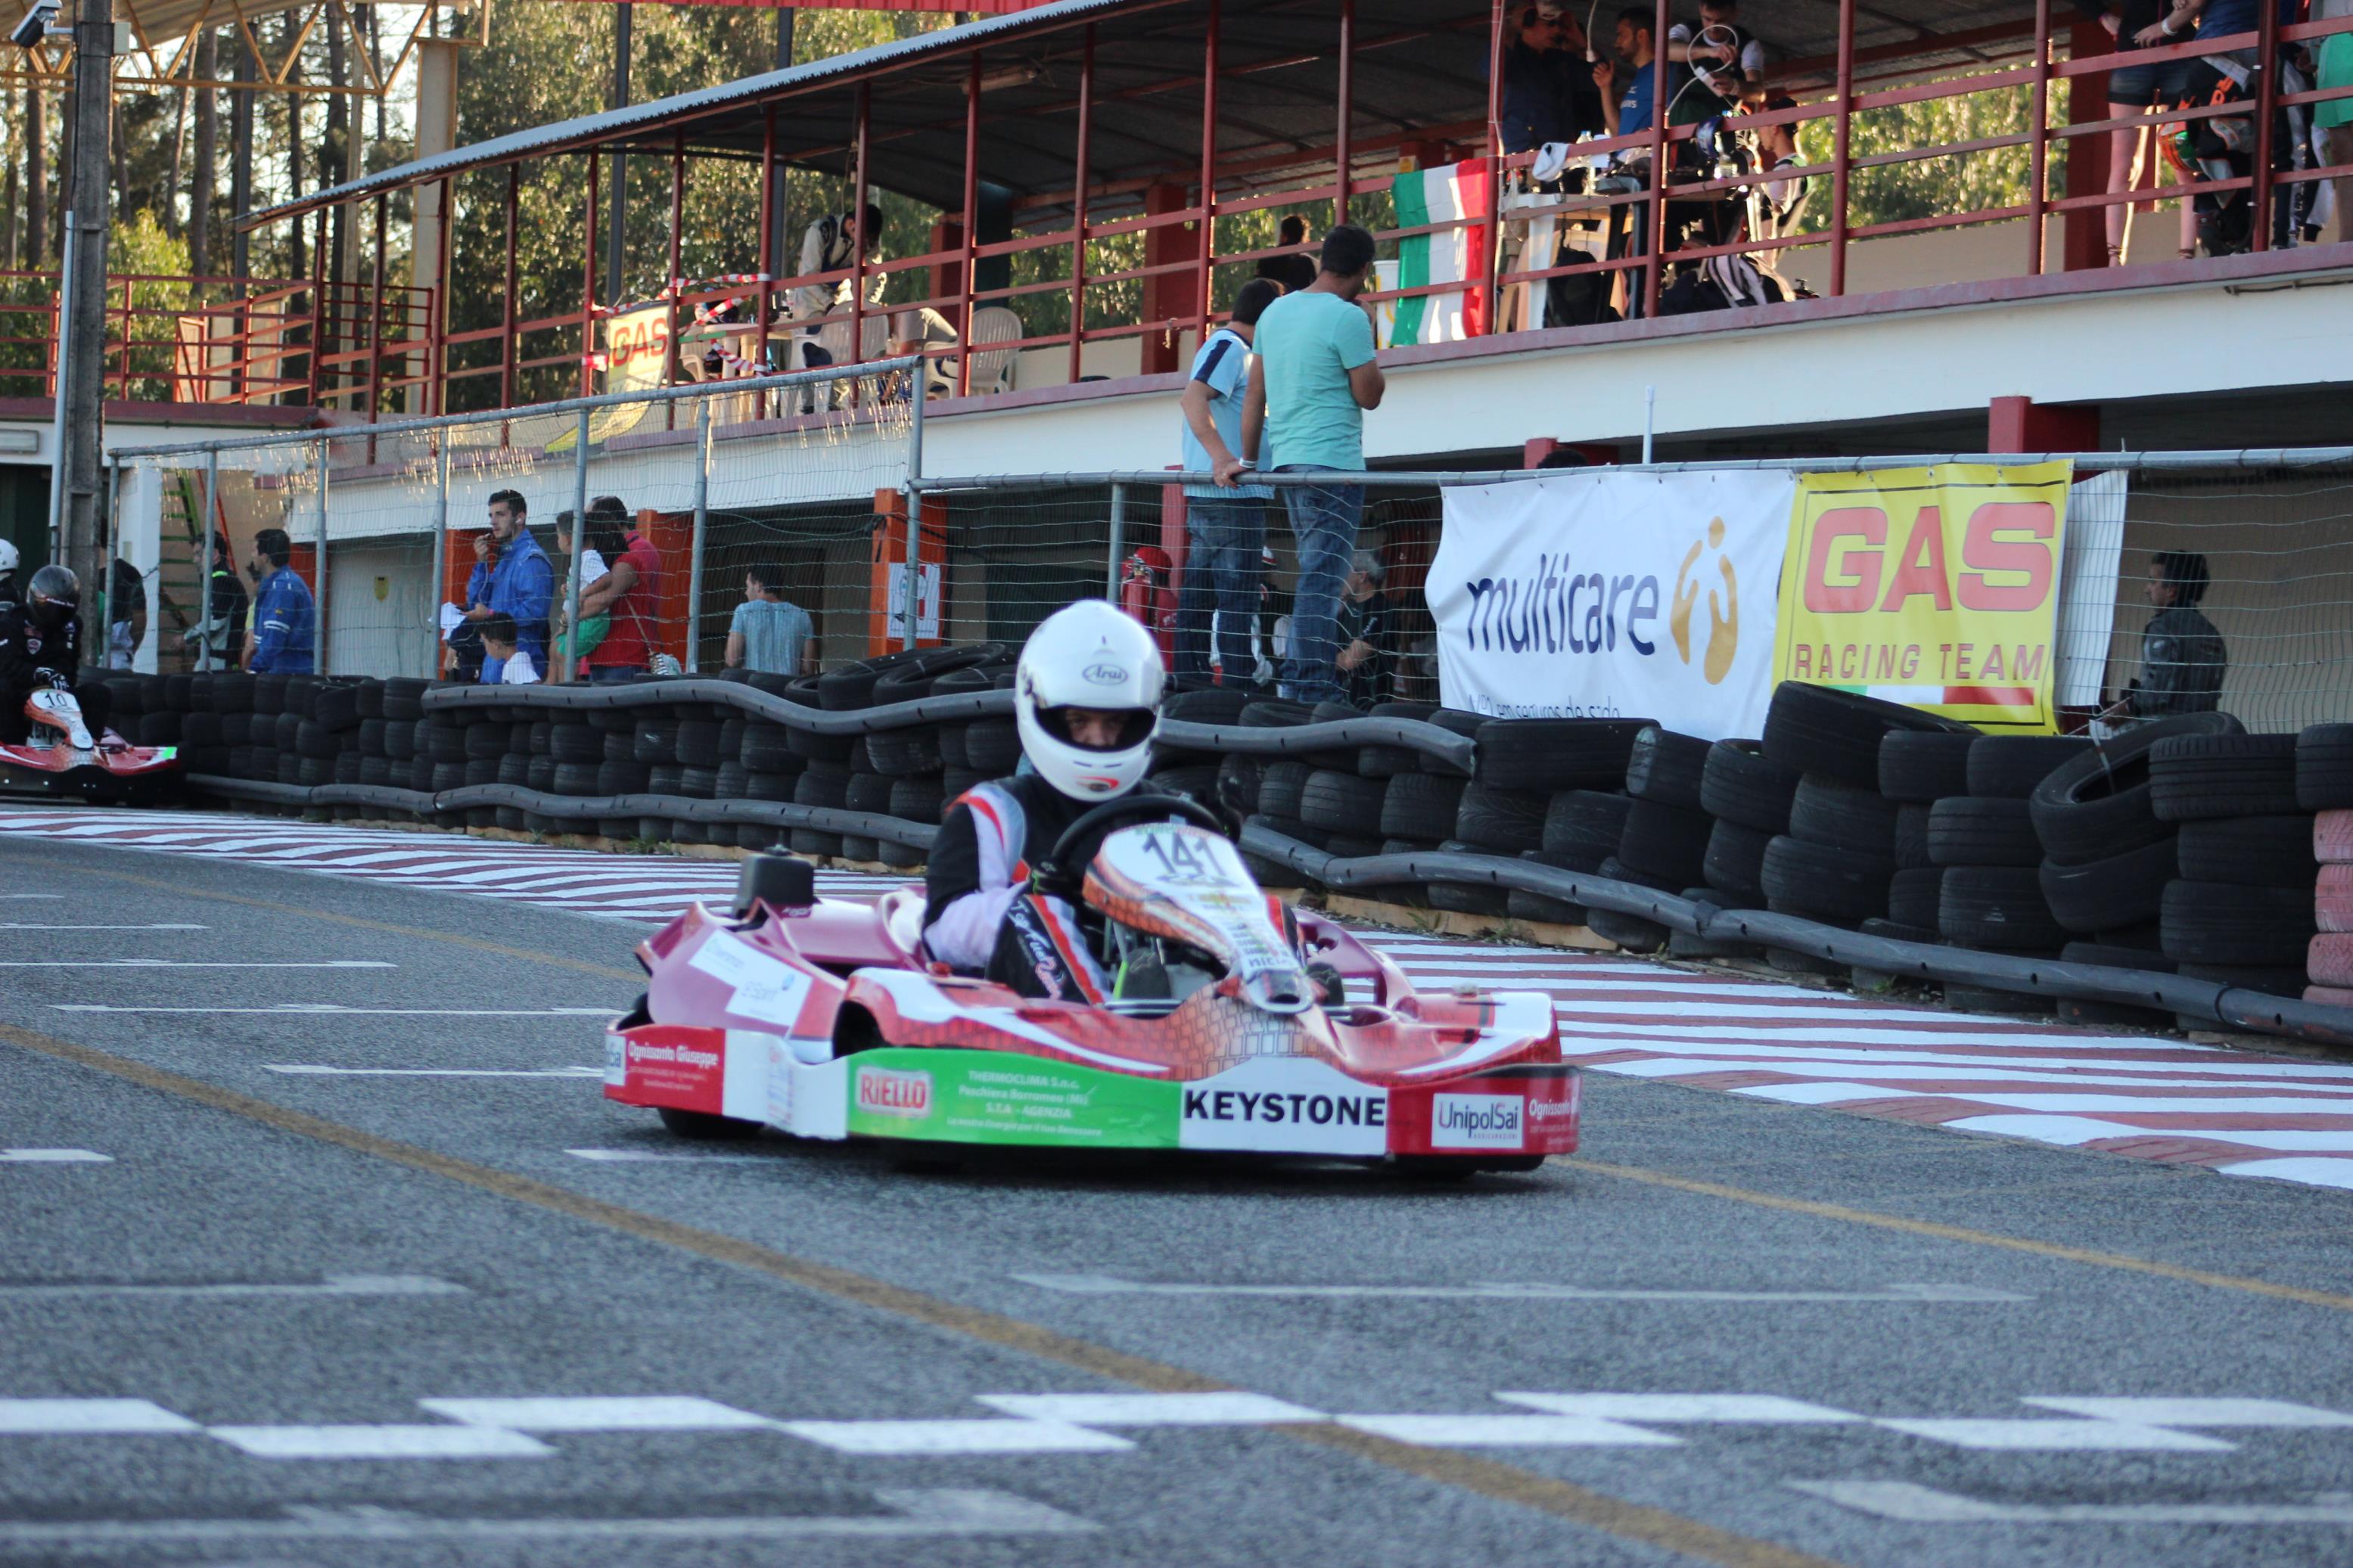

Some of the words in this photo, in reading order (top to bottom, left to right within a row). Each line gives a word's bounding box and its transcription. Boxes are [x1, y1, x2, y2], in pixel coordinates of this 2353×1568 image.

[612, 317, 668, 368] GAS
[1803, 501, 2056, 614] GAS
[1466, 552, 1659, 656] multicare
[1793, 644, 1922, 679] RACING
[1939, 643, 2046, 681] TEAM
[44, 692, 68, 709] 10
[1141, 832, 1228, 877] 141
[860, 1073, 927, 1109] RIELLO
[968, 1070, 1049, 1087] THERMOCLIMA
[1022, 1105, 1073, 1119] AGENZIA
[1183, 1089, 1386, 1127] KEYSTONE
[1438, 1101, 1518, 1139] UnipolSai
